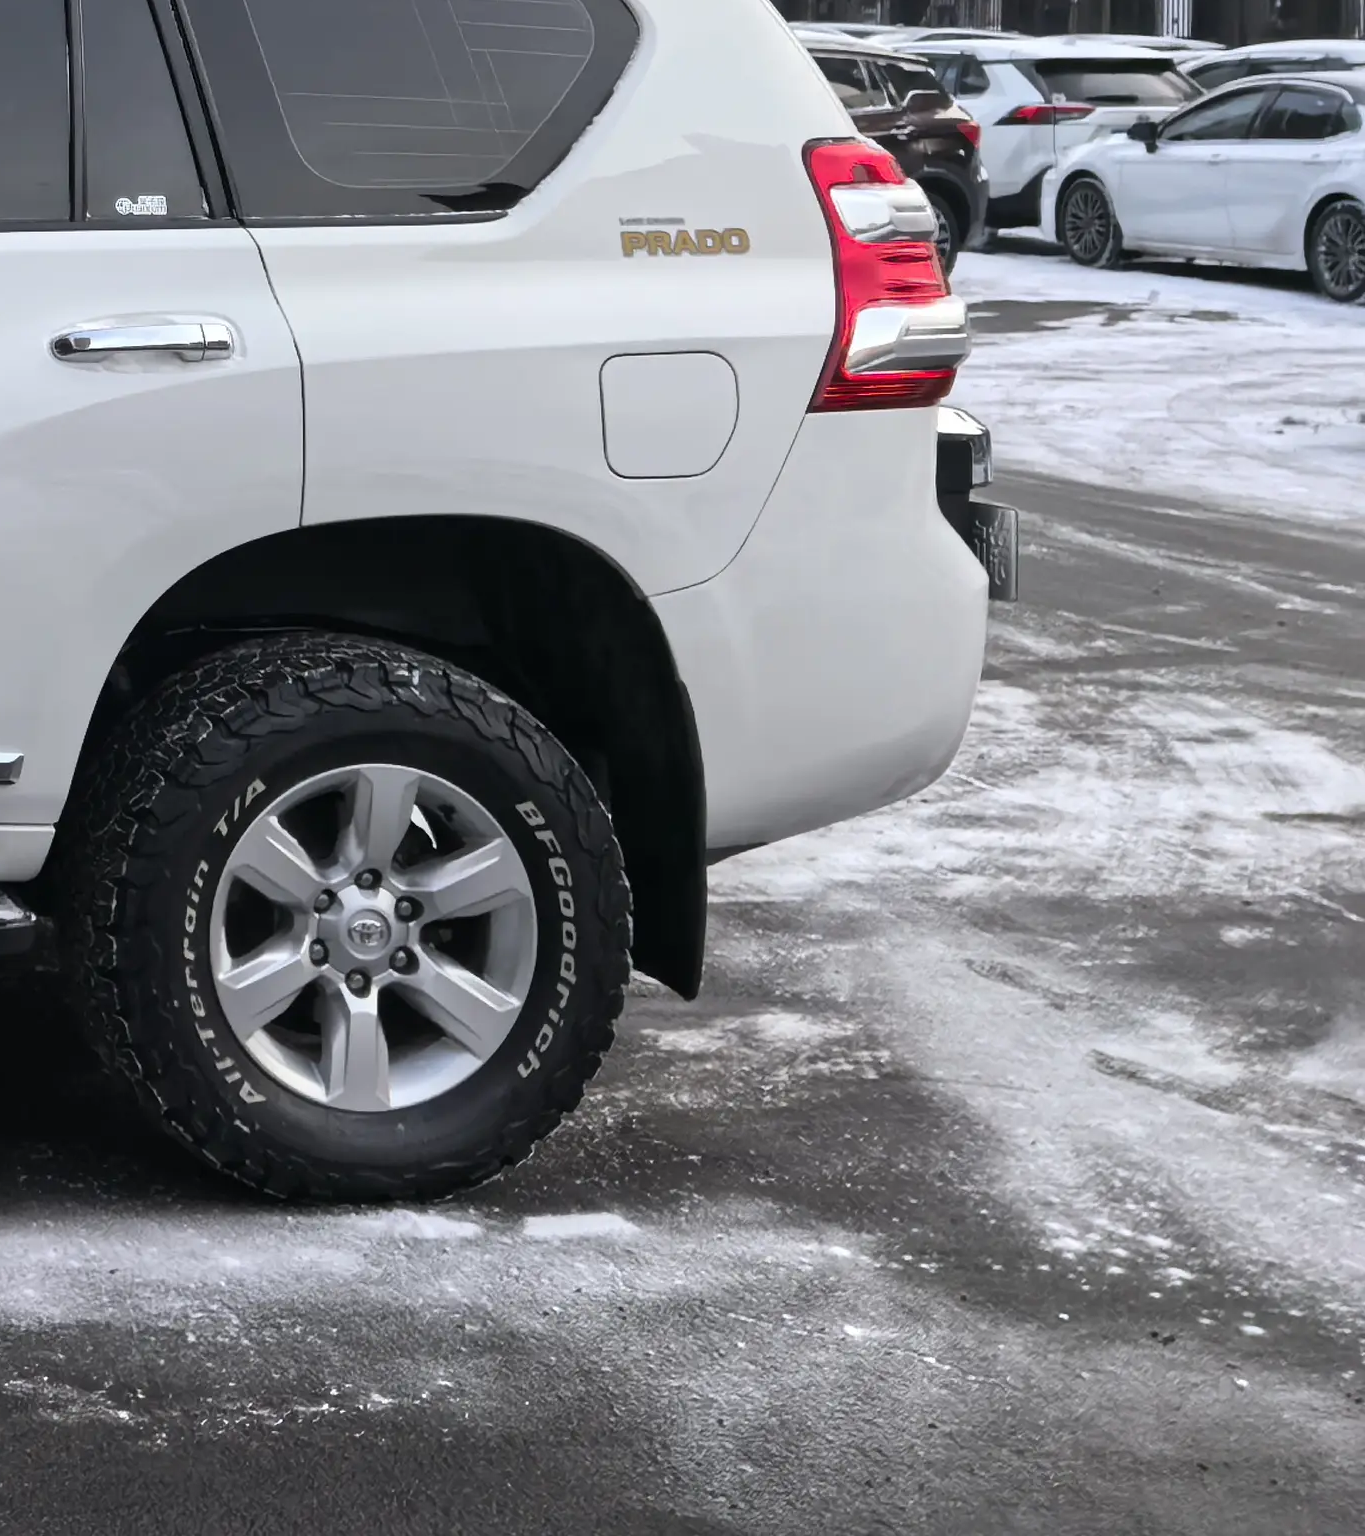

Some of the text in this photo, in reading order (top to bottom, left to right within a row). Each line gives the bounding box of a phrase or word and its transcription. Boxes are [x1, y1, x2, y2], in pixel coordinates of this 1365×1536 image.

[620, 227, 751, 258] PRADO
[182, 776, 268, 1107] All-Terrain T/A
[514, 800, 578, 1079] BFGoodrich
